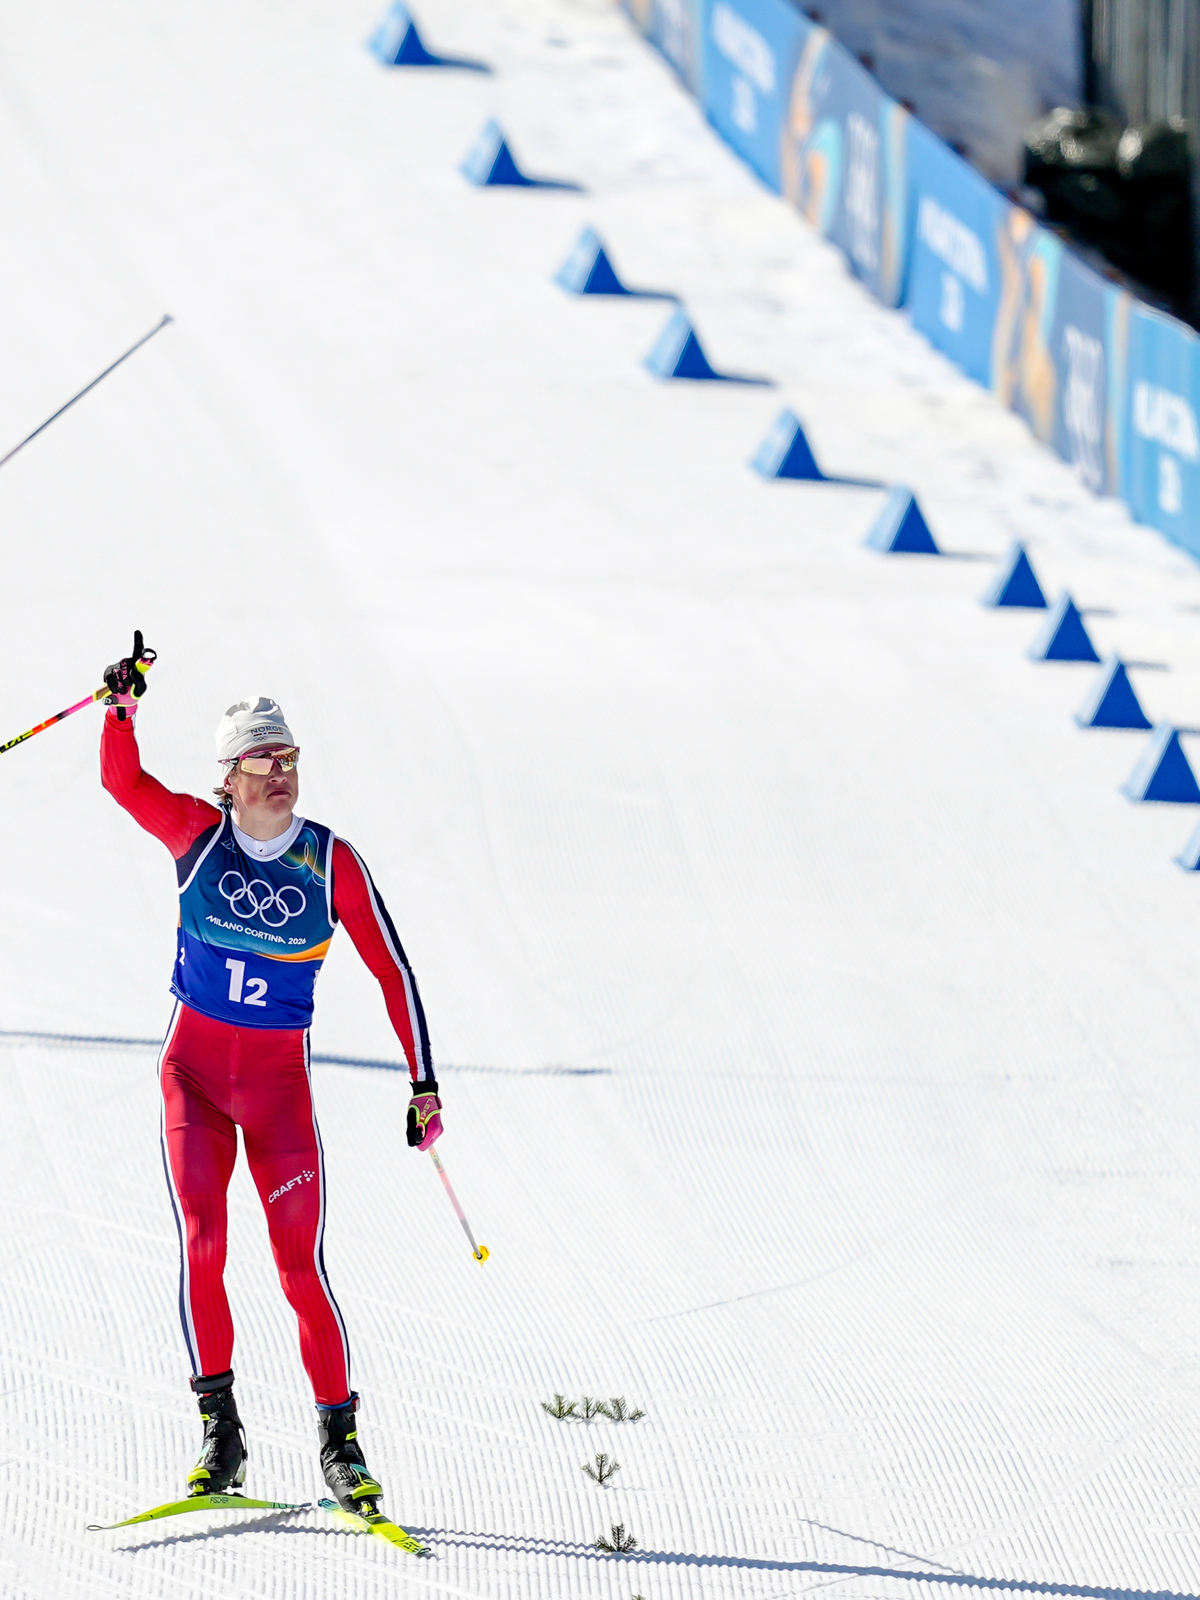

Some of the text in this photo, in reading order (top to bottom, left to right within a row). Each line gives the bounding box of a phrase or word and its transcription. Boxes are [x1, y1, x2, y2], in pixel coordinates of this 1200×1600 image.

[250, 725, 284, 735] NORGE
[205, 914, 307, 945] MILANO CORTINA 2026
[268, 1174, 303, 1204] CRAFT
